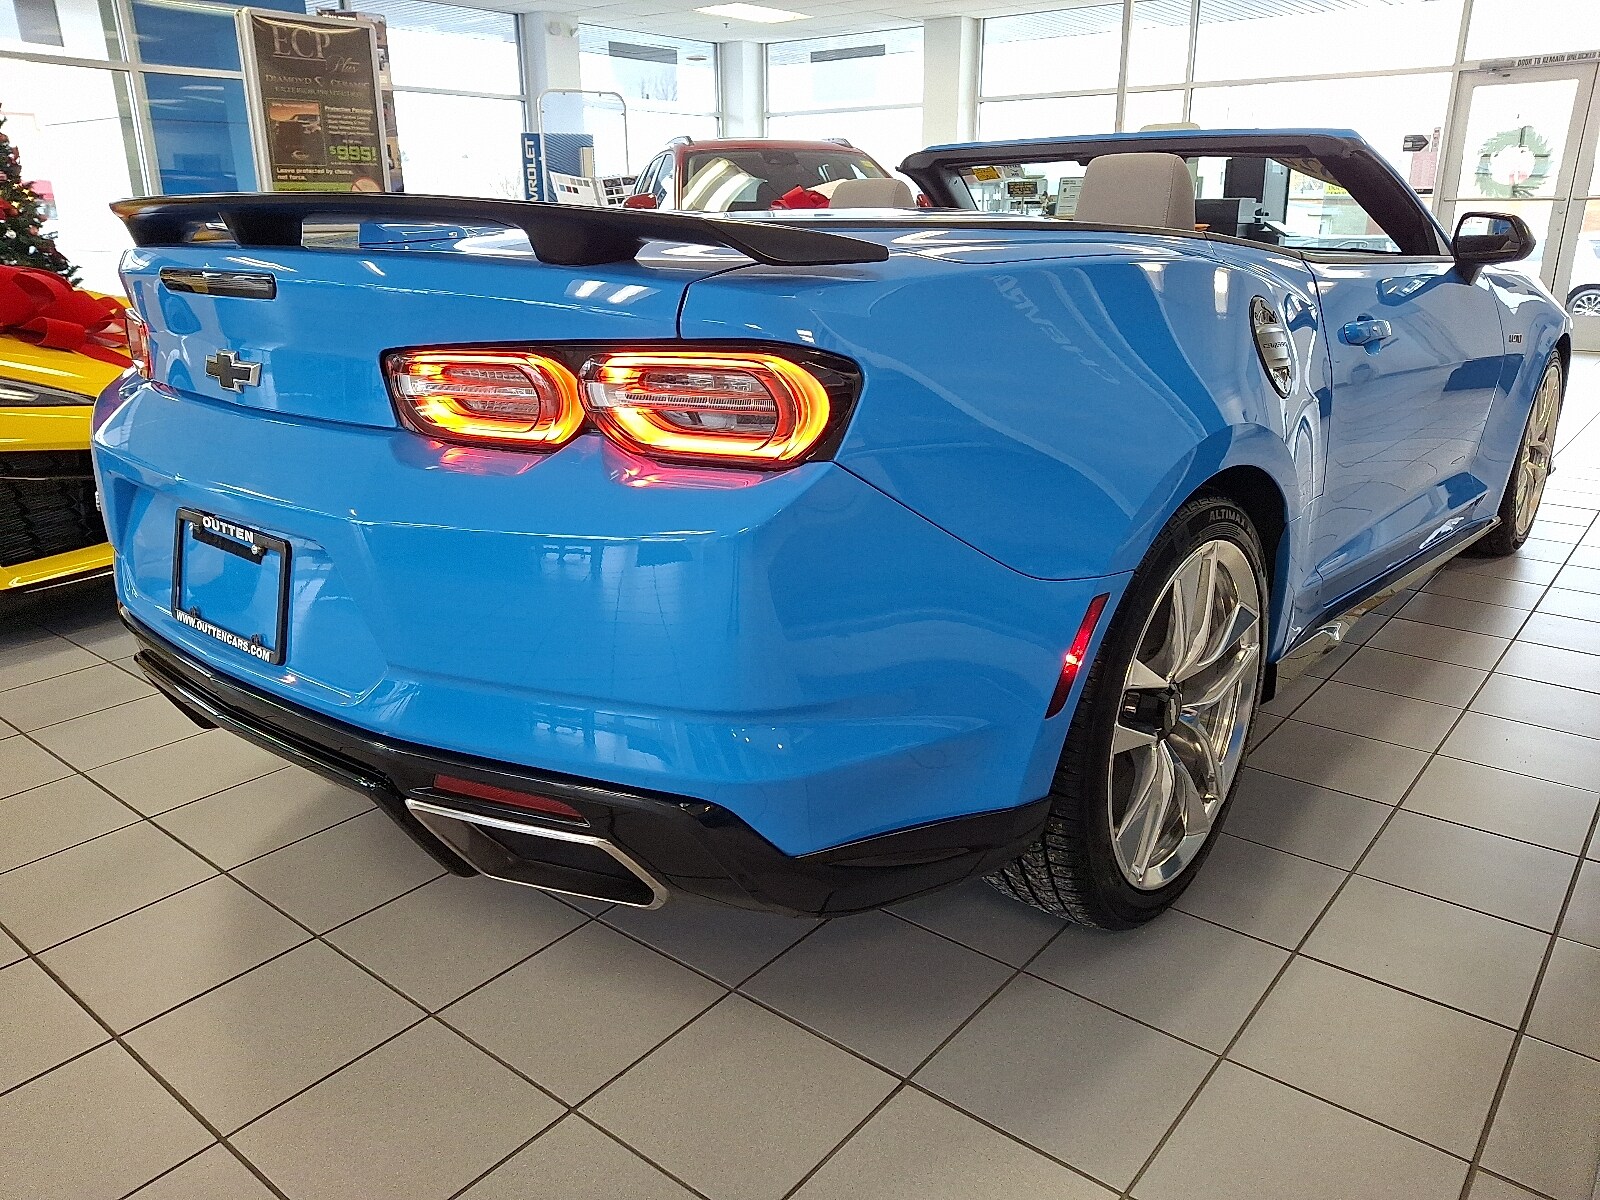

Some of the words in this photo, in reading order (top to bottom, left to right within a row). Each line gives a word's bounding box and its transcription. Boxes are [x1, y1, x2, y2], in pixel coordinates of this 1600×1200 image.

[271, 26, 331, 59] ECP
[332, 55, 360, 73] Plus
[265, 74, 312, 85] DIAMOND
[202, 516, 254, 544] OUTTEN
[175, 609, 271, 663] WWW.OUTTENCARS.COM
